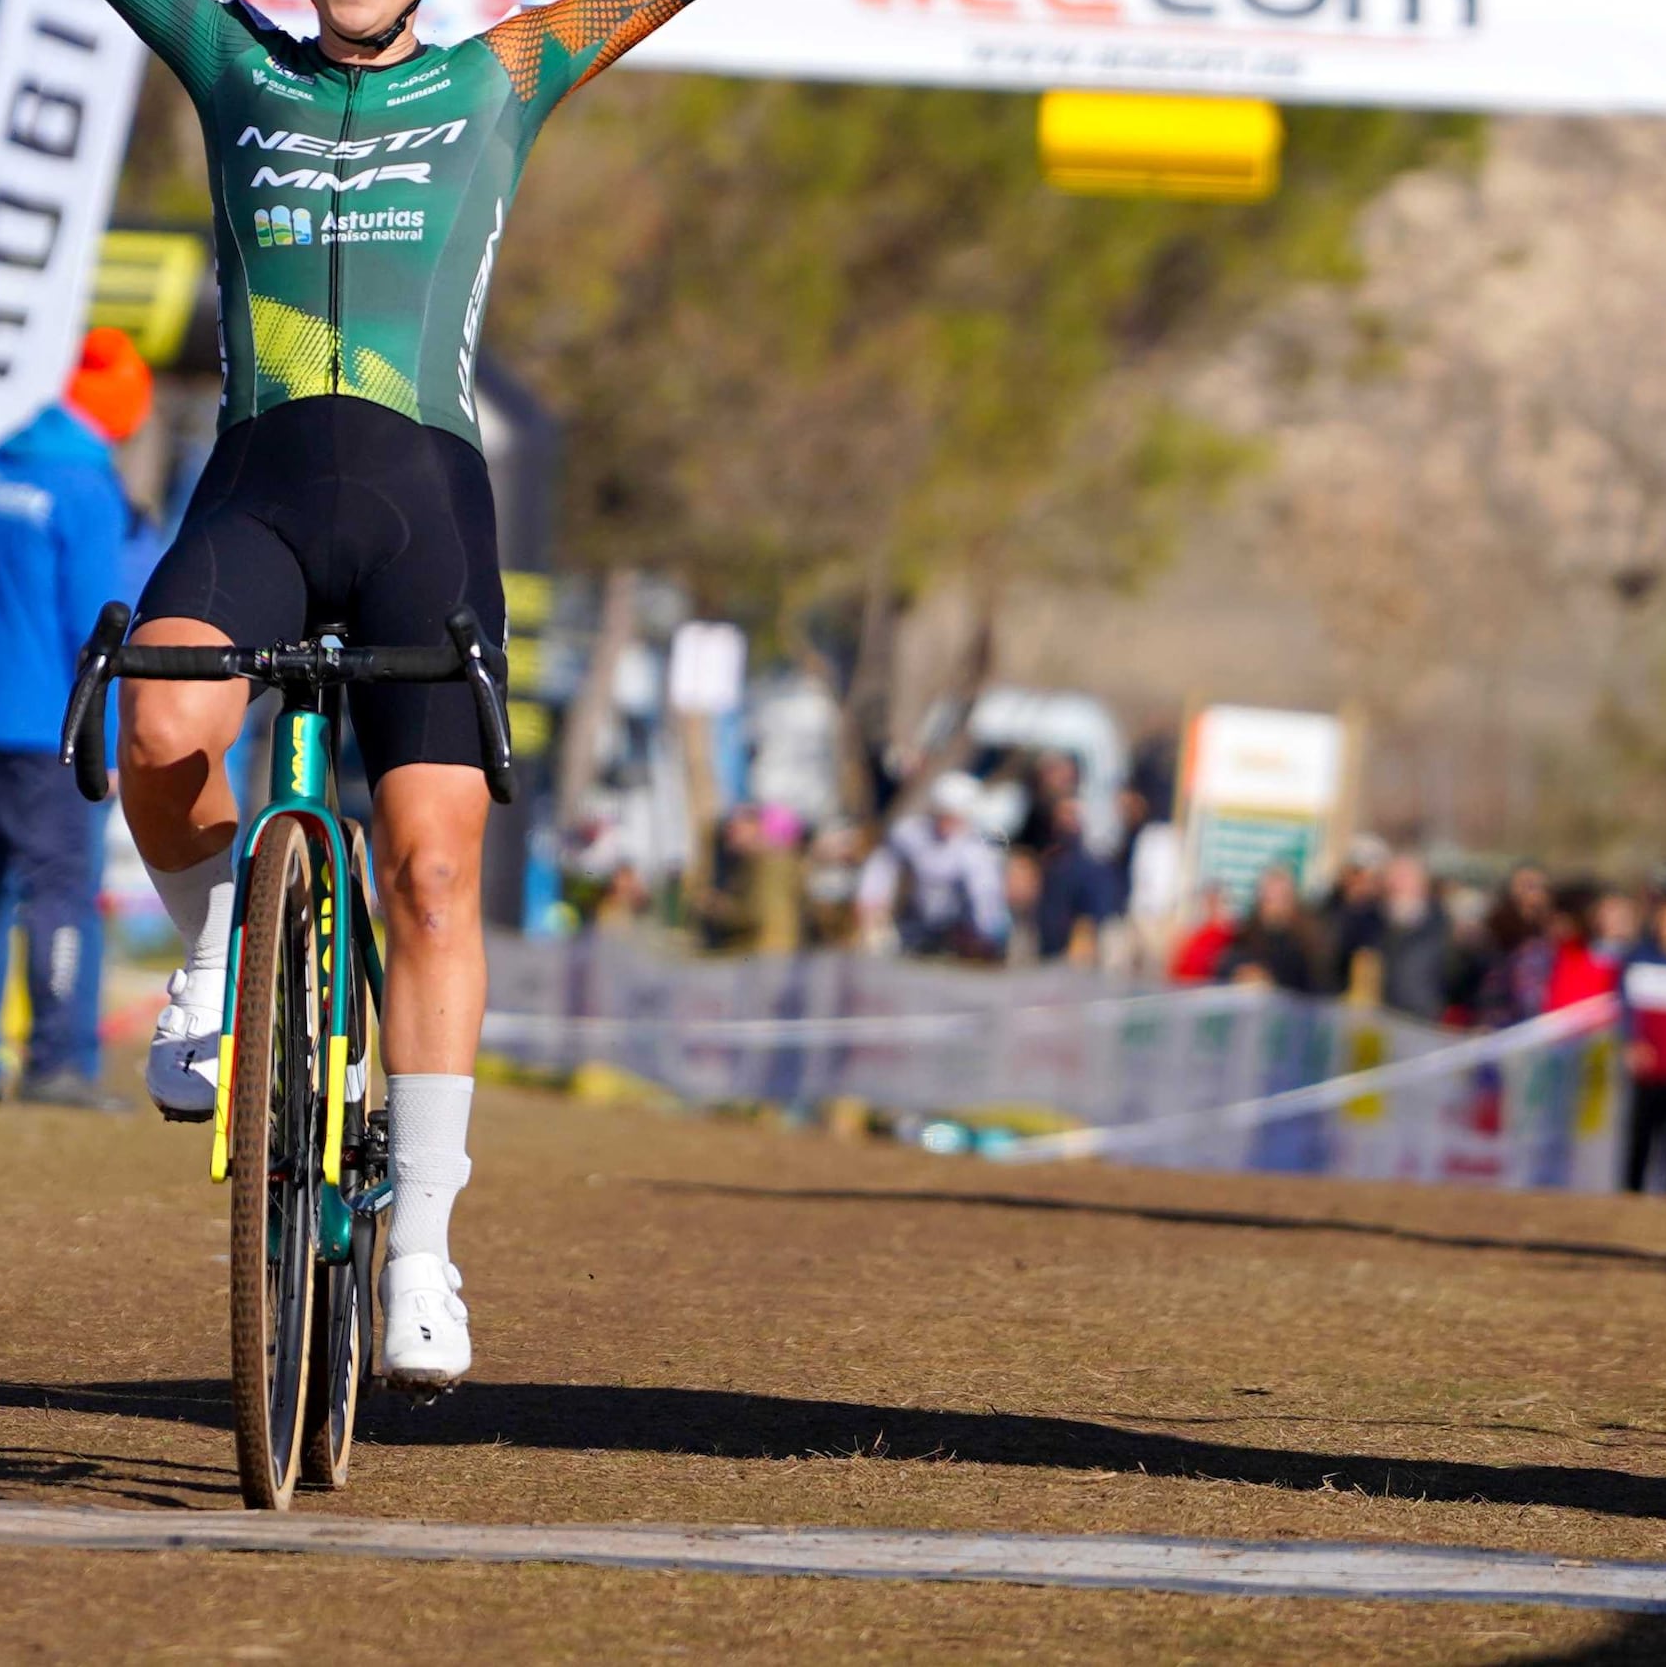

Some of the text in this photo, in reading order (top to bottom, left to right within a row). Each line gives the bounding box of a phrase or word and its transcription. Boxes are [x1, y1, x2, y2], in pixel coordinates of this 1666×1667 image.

[236, 118, 468, 160] NESTA
[250, 162, 432, 192] MMR
[320, 206, 425, 231] Asturias
[372, 228, 424, 242] natural
